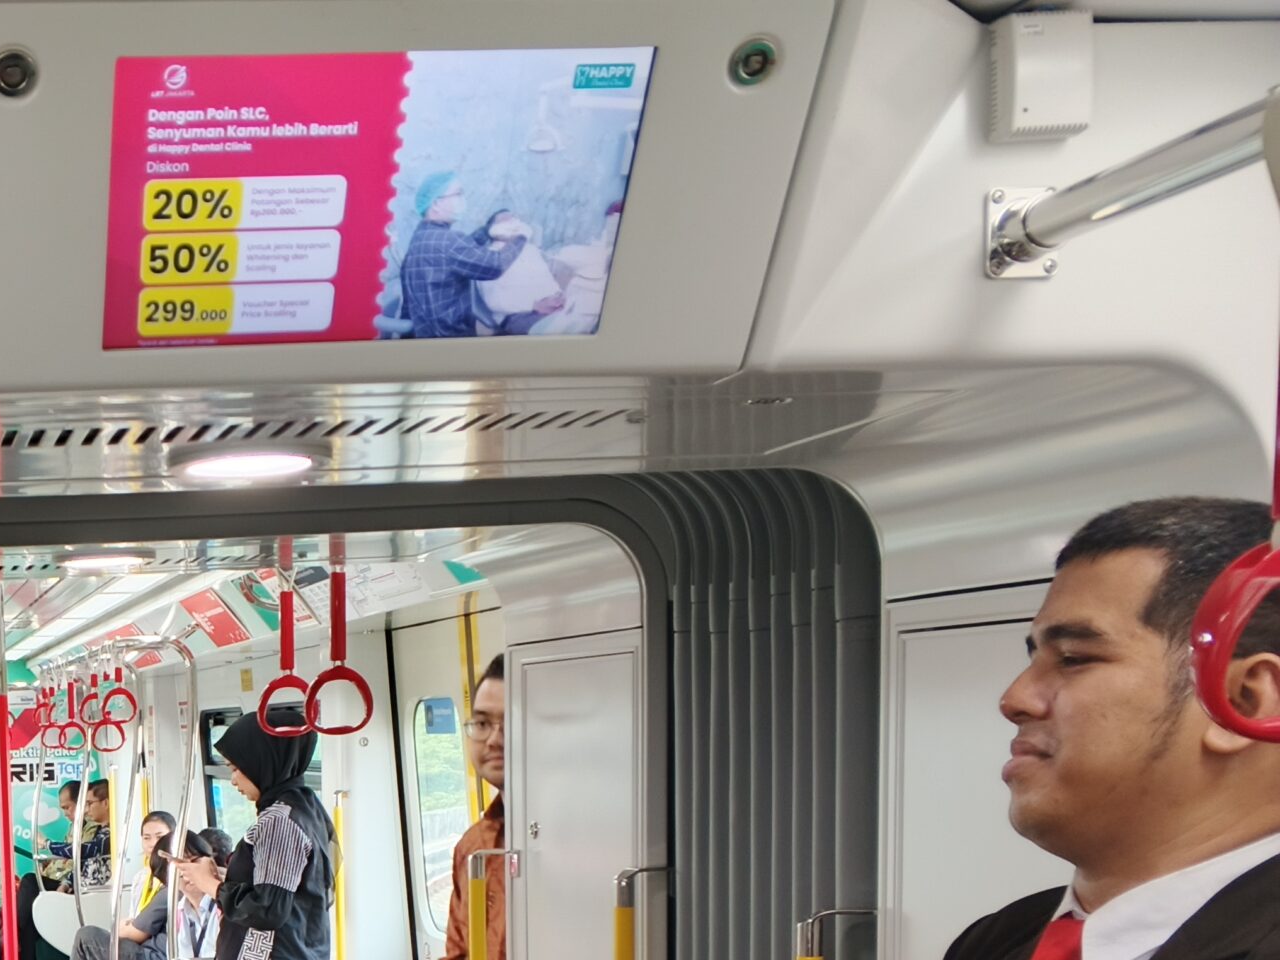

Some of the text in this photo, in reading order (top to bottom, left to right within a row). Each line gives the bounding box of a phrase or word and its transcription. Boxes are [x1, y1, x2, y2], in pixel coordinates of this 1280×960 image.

[588, 66, 634, 78] HAPPY
[147, 106, 270, 125] Dengan Poin SLC,
[147, 121, 358, 141] Senyuman Kamu lebih Berarti
[147, 141, 253, 155] di Happy Dental Clinic
[146, 160, 190, 174] Diskon
[152, 188, 233, 220] 20%
[149, 243, 229, 274] 50%
[144, 299, 228, 323] 299.000
